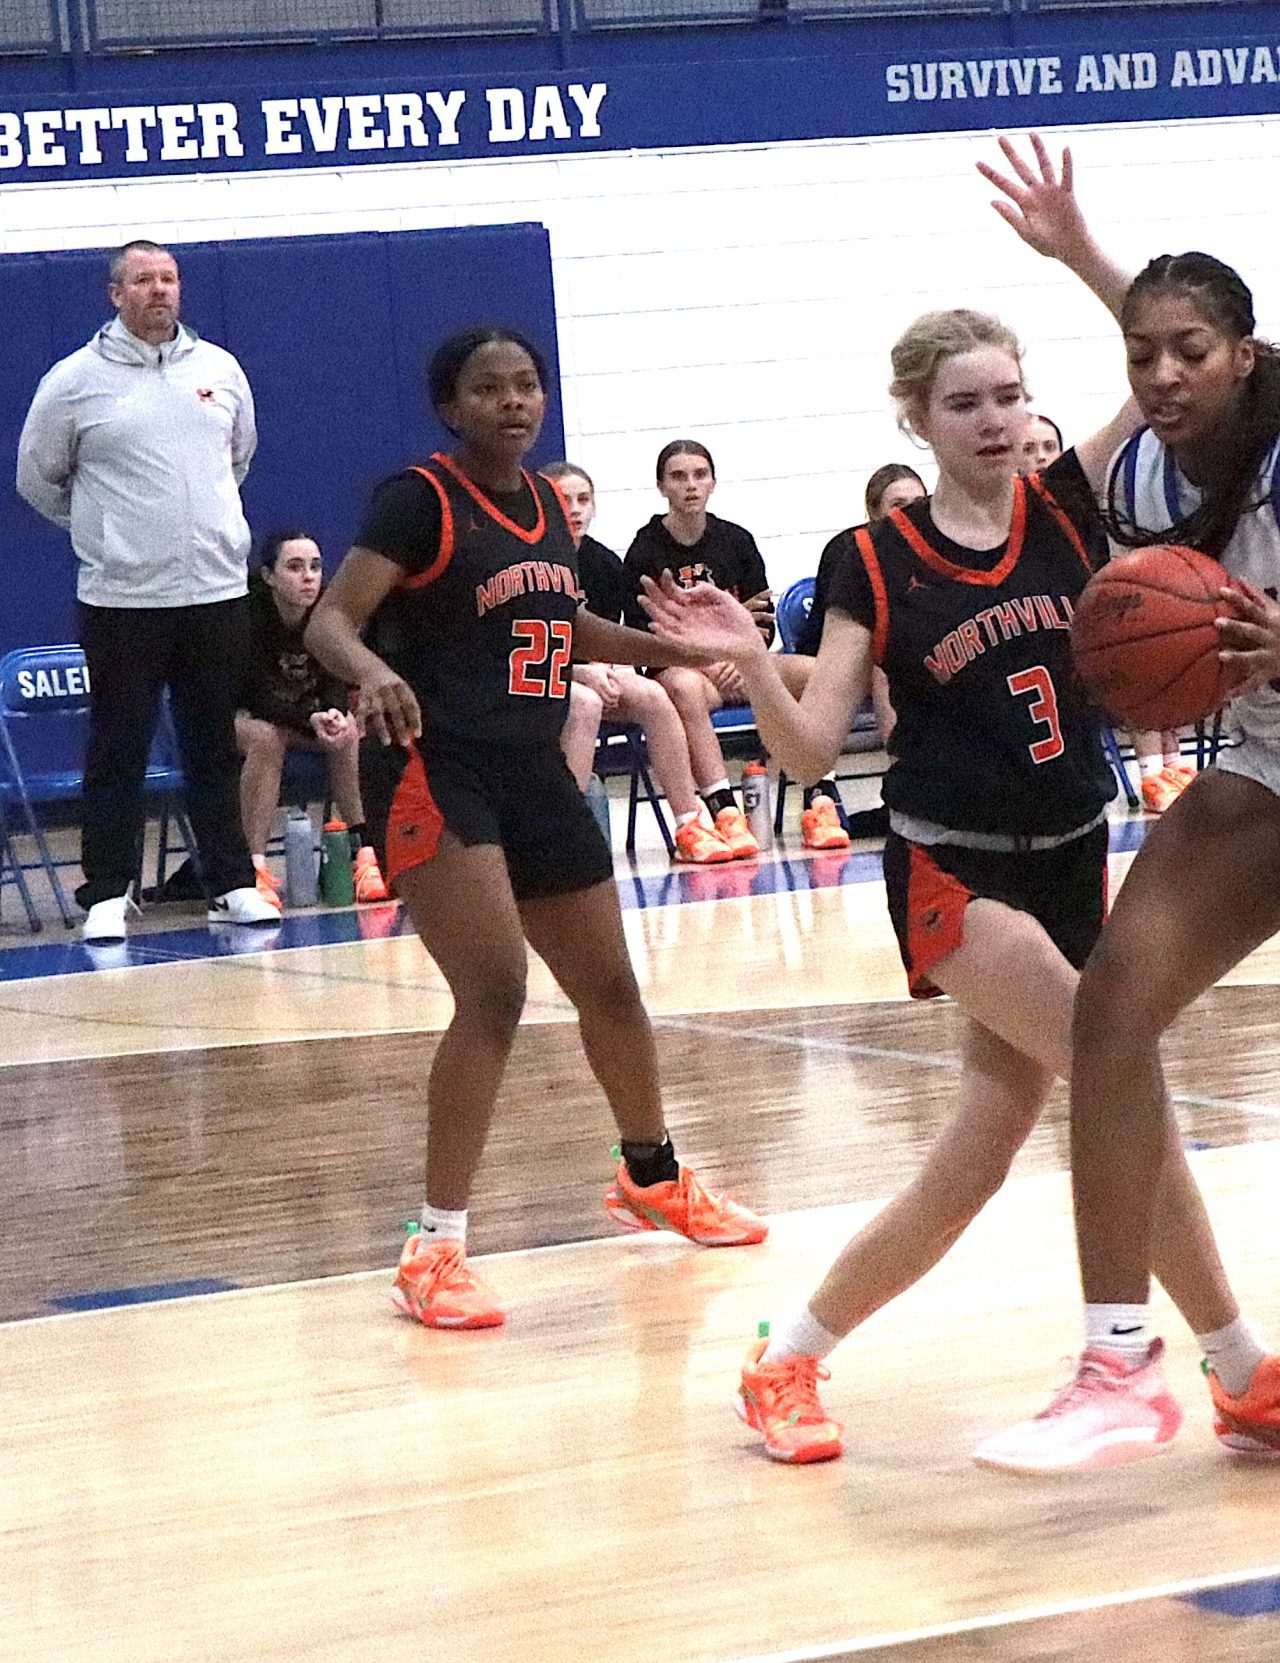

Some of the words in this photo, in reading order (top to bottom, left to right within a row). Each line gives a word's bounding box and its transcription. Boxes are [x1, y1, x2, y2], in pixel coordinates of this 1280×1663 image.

[886, 56, 1062, 102] SURVIVE
[1076, 51, 1157, 93] AND
[0, 102, 244, 168] BETTER
[262, 90, 465, 154] EVERY
[486, 83, 607, 143] DAY
[509, 619, 572, 698] 22
[1006, 665, 1064, 764] 3
